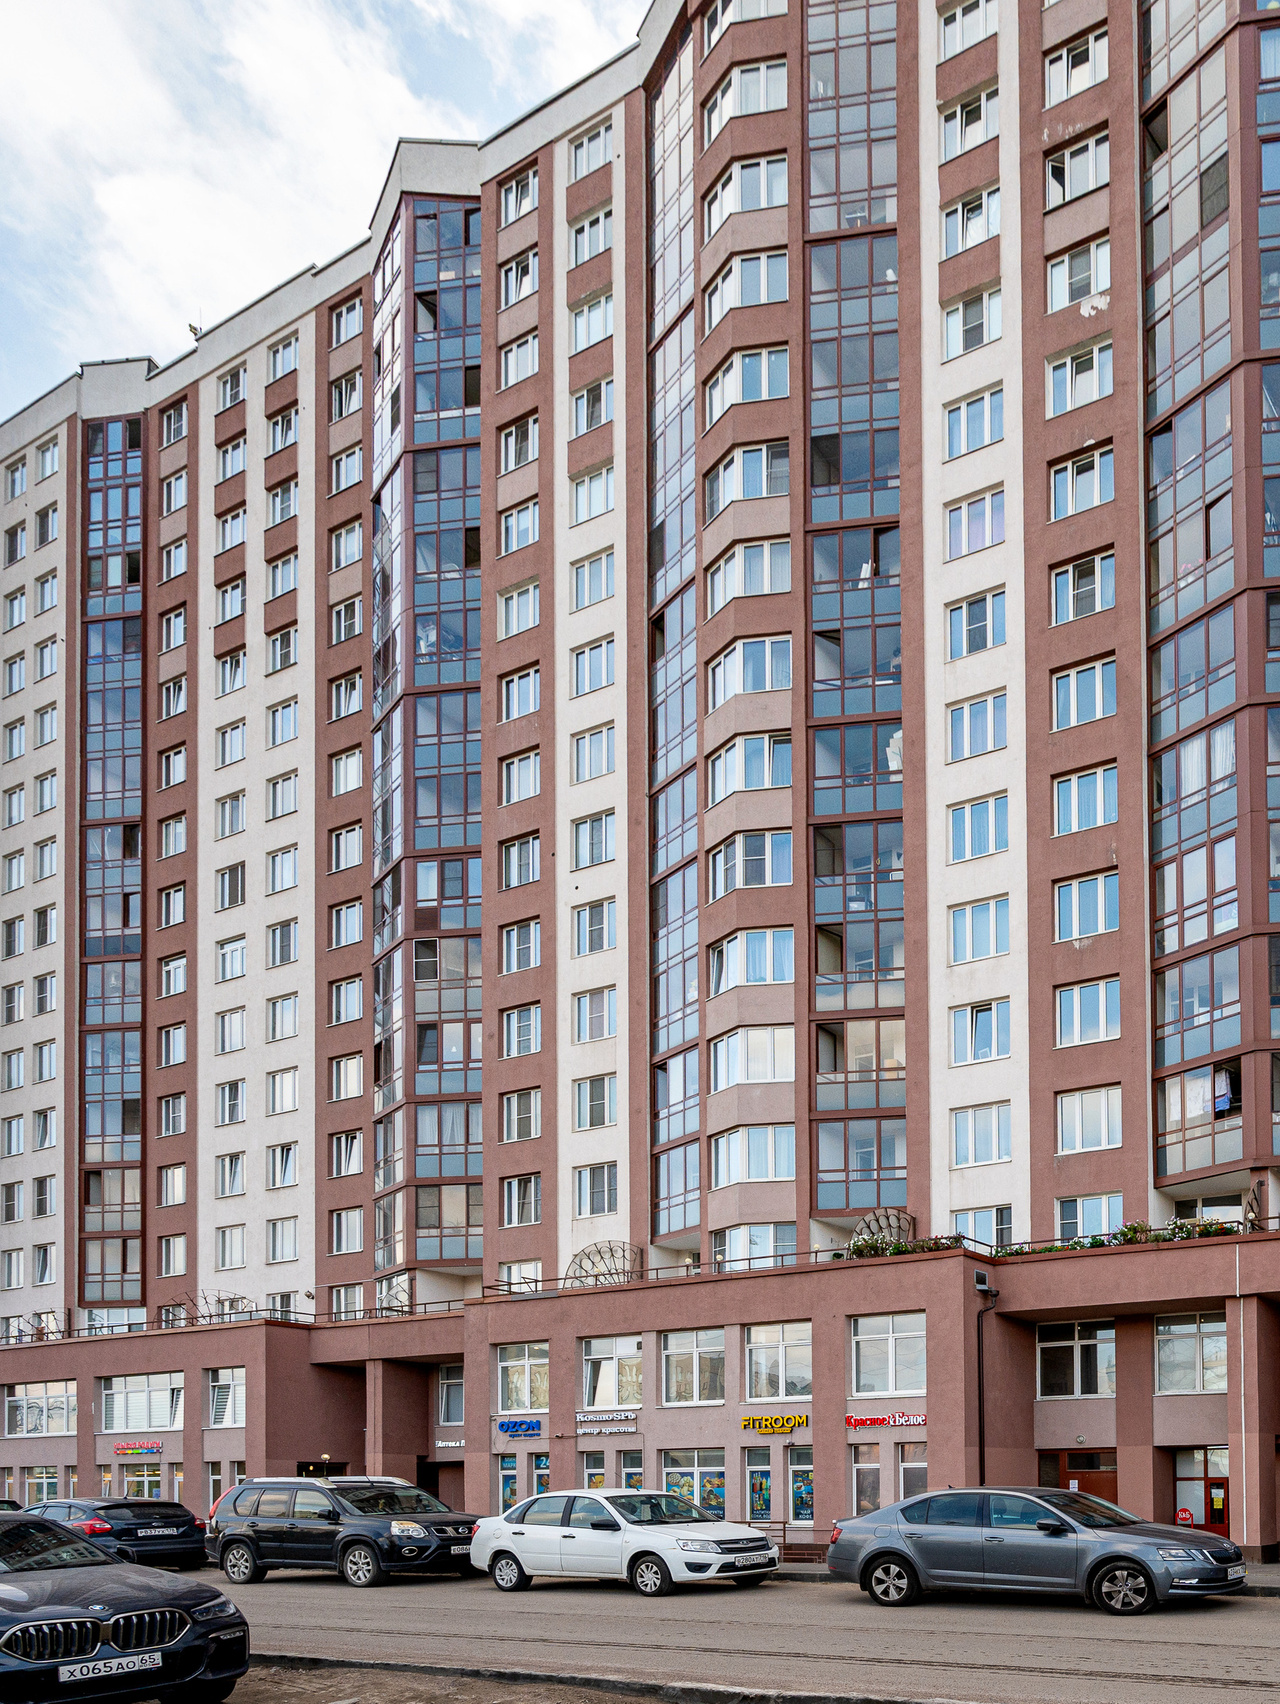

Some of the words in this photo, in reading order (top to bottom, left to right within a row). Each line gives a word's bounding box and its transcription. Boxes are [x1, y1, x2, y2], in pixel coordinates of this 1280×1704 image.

[576, 1413, 613, 1422] Kosmo
[742, 1415, 807, 1430] FITROOM
[499, 1420, 541, 1432] OZON
[67, 1661, 136, 1679] Х065АО
[140, 1655, 156, 1665] 65
